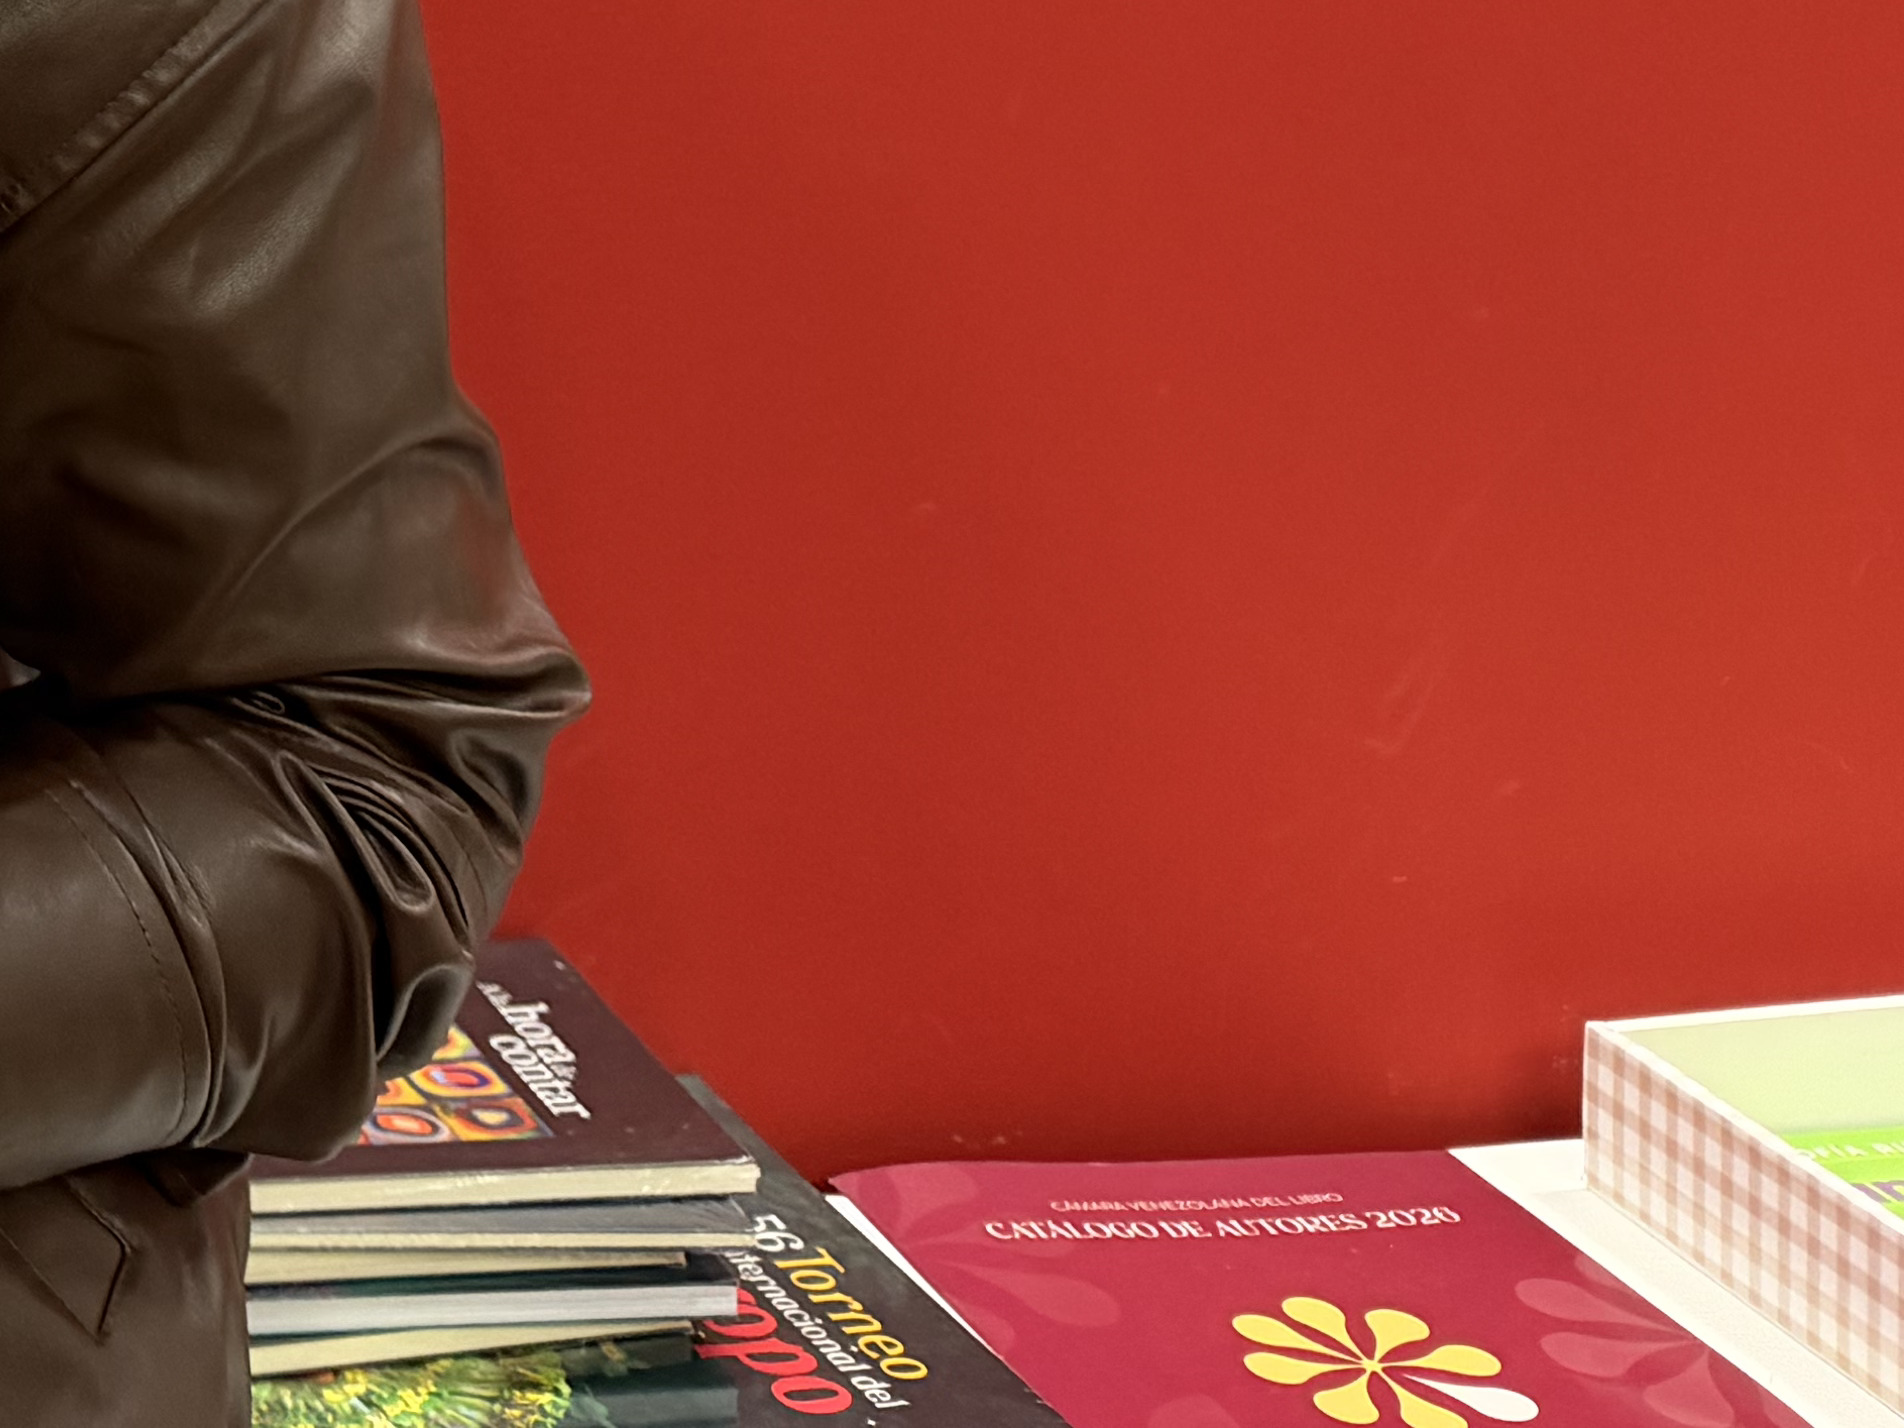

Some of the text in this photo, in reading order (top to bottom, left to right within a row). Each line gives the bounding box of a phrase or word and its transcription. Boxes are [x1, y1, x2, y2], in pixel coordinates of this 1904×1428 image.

[488, 1032, 593, 1120] contar
[1125, 1198, 1251, 1212] VENEZOLANA
[1248, 1195, 1290, 1208] DEL
[1288, 1192, 1344, 1206] LIBRO
[1158, 1220, 1213, 1240] DE
[1215, 1213, 1368, 1239] AUTORES
[724, 1251, 911, 1409] ternacional del
[752, 1213, 929, 1380] 56 Torneo
